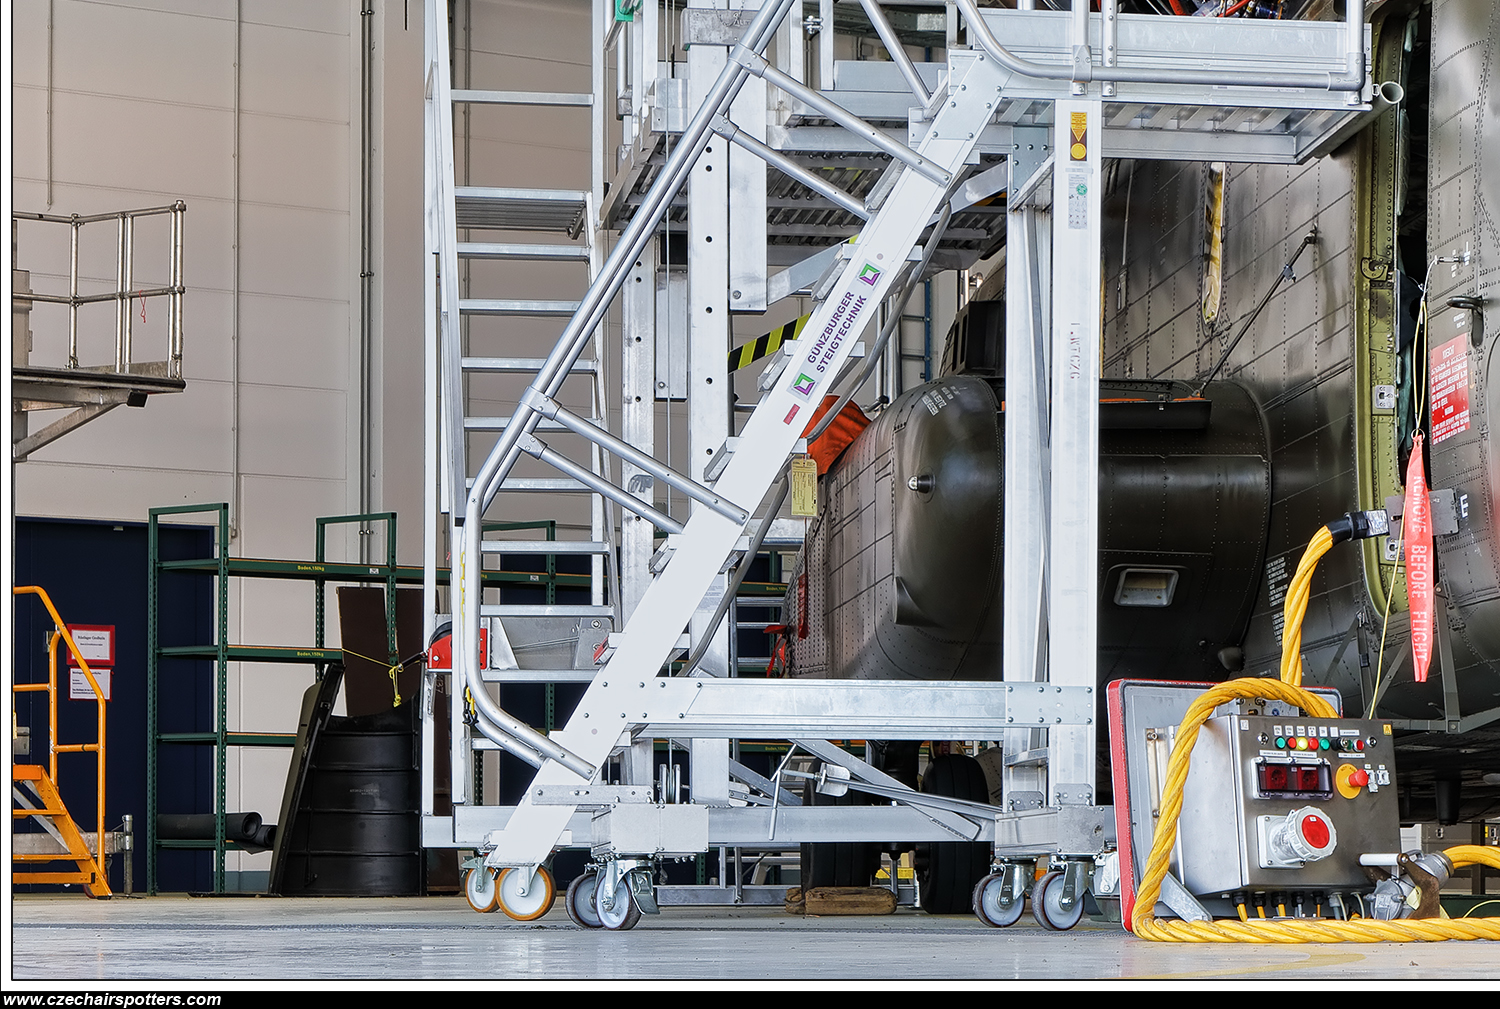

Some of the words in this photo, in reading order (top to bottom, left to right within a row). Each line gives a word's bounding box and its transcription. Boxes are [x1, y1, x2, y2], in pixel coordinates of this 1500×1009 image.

[807, 291, 855, 364] GÜNZBURGER
[816, 295, 867, 373] STEIGTECHNIK
[1412, 476, 1427, 534] REMOVE
[1410, 545, 1427, 599] BEFORE
[1411, 610, 1428, 662] FLIGHT
